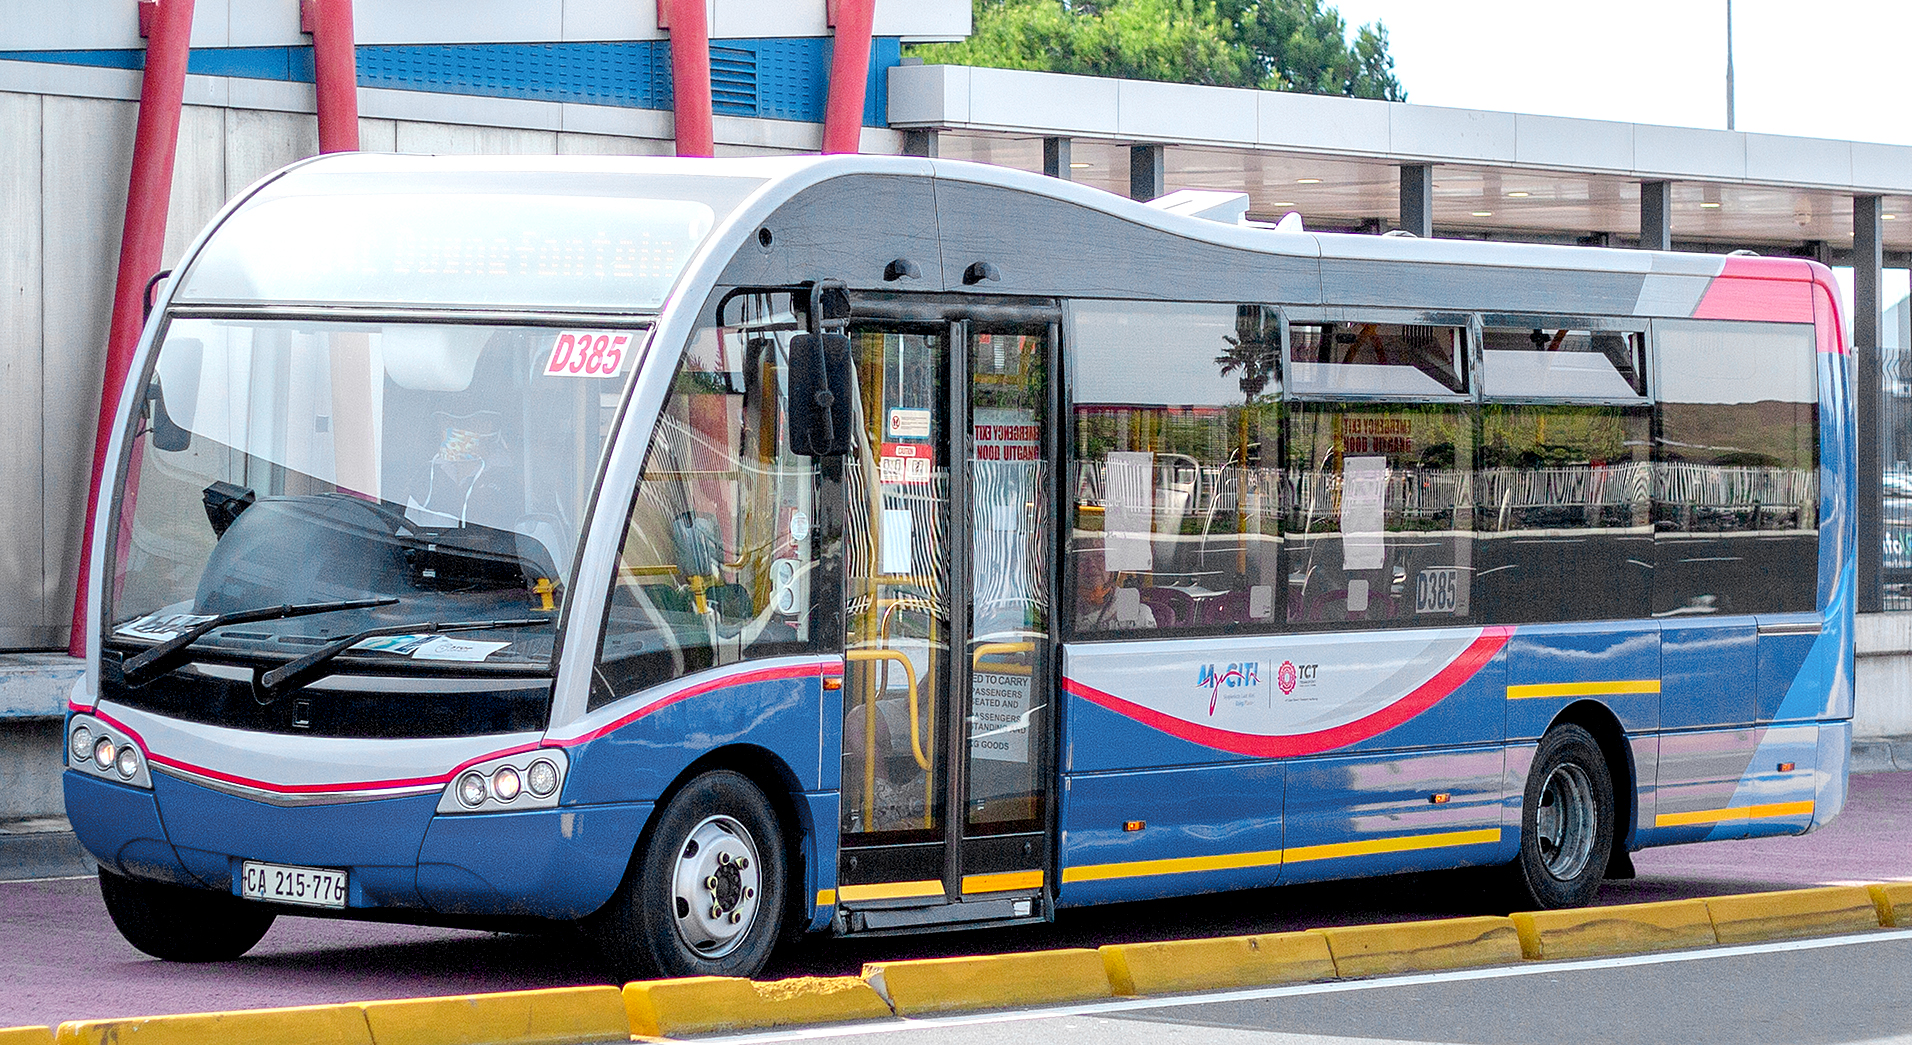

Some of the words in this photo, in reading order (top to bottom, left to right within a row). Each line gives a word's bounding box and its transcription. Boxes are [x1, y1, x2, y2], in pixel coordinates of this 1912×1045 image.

[548, 334, 628, 375] D385
[976, 445, 1000, 461] NOOD
[1003, 445, 1040, 461] UITGANG
[1417, 571, 1456, 610] D385
[1298, 664, 1319, 680] TCT
[985, 674, 997, 684] TO
[998, 676, 1029, 687] CARRY
[973, 697, 1001, 707] EATED
[1002, 700, 1019, 709] AND
[974, 712, 1021, 722] ASSENGERS
[981, 741, 1010, 751] GOODS
[247, 868, 267, 893] CA
[275, 871, 343, 901] 215-776
